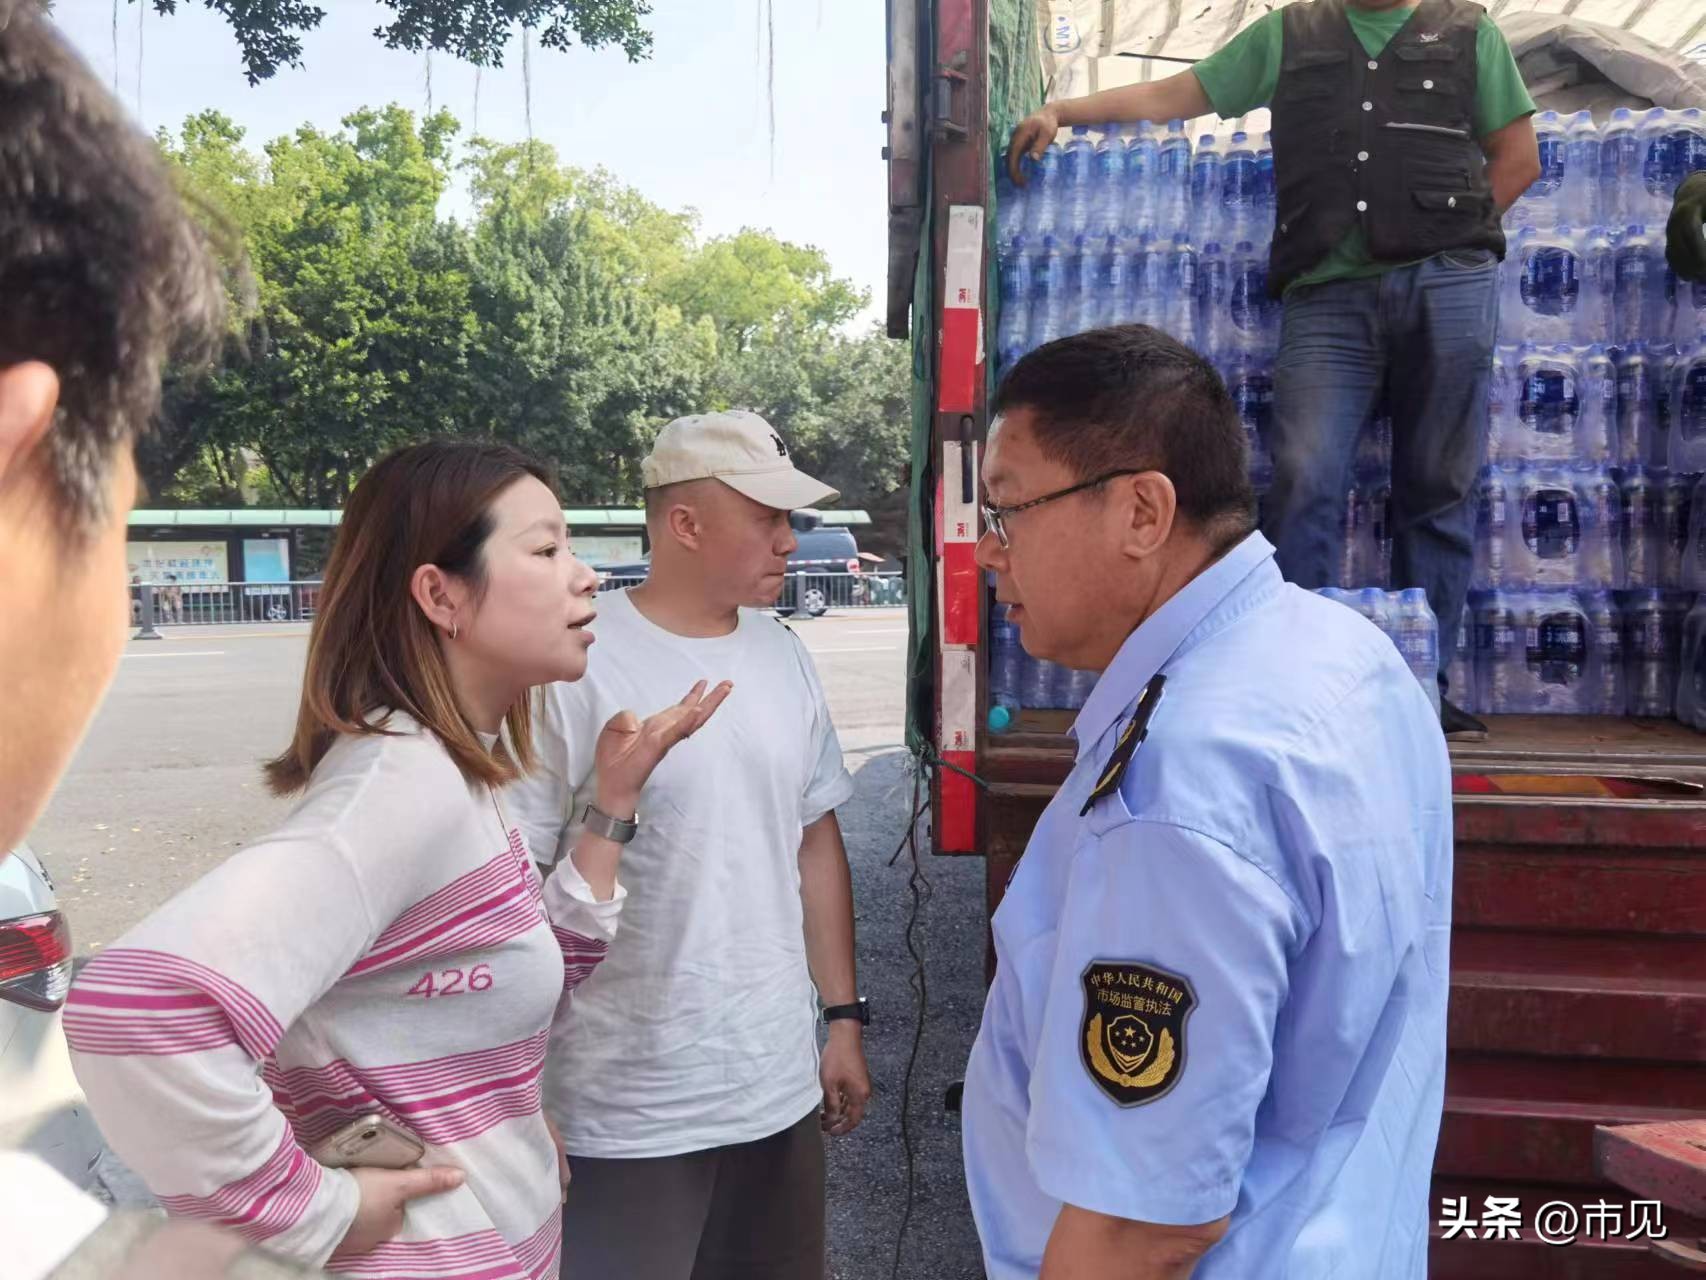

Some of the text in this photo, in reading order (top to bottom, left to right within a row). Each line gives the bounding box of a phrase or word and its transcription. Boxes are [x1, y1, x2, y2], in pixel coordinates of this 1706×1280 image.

[407, 963, 493, 998] 426
[1091, 972, 1183, 1004] 中华人民共和国
[1097, 989, 1172, 1016] 市场监管执法
